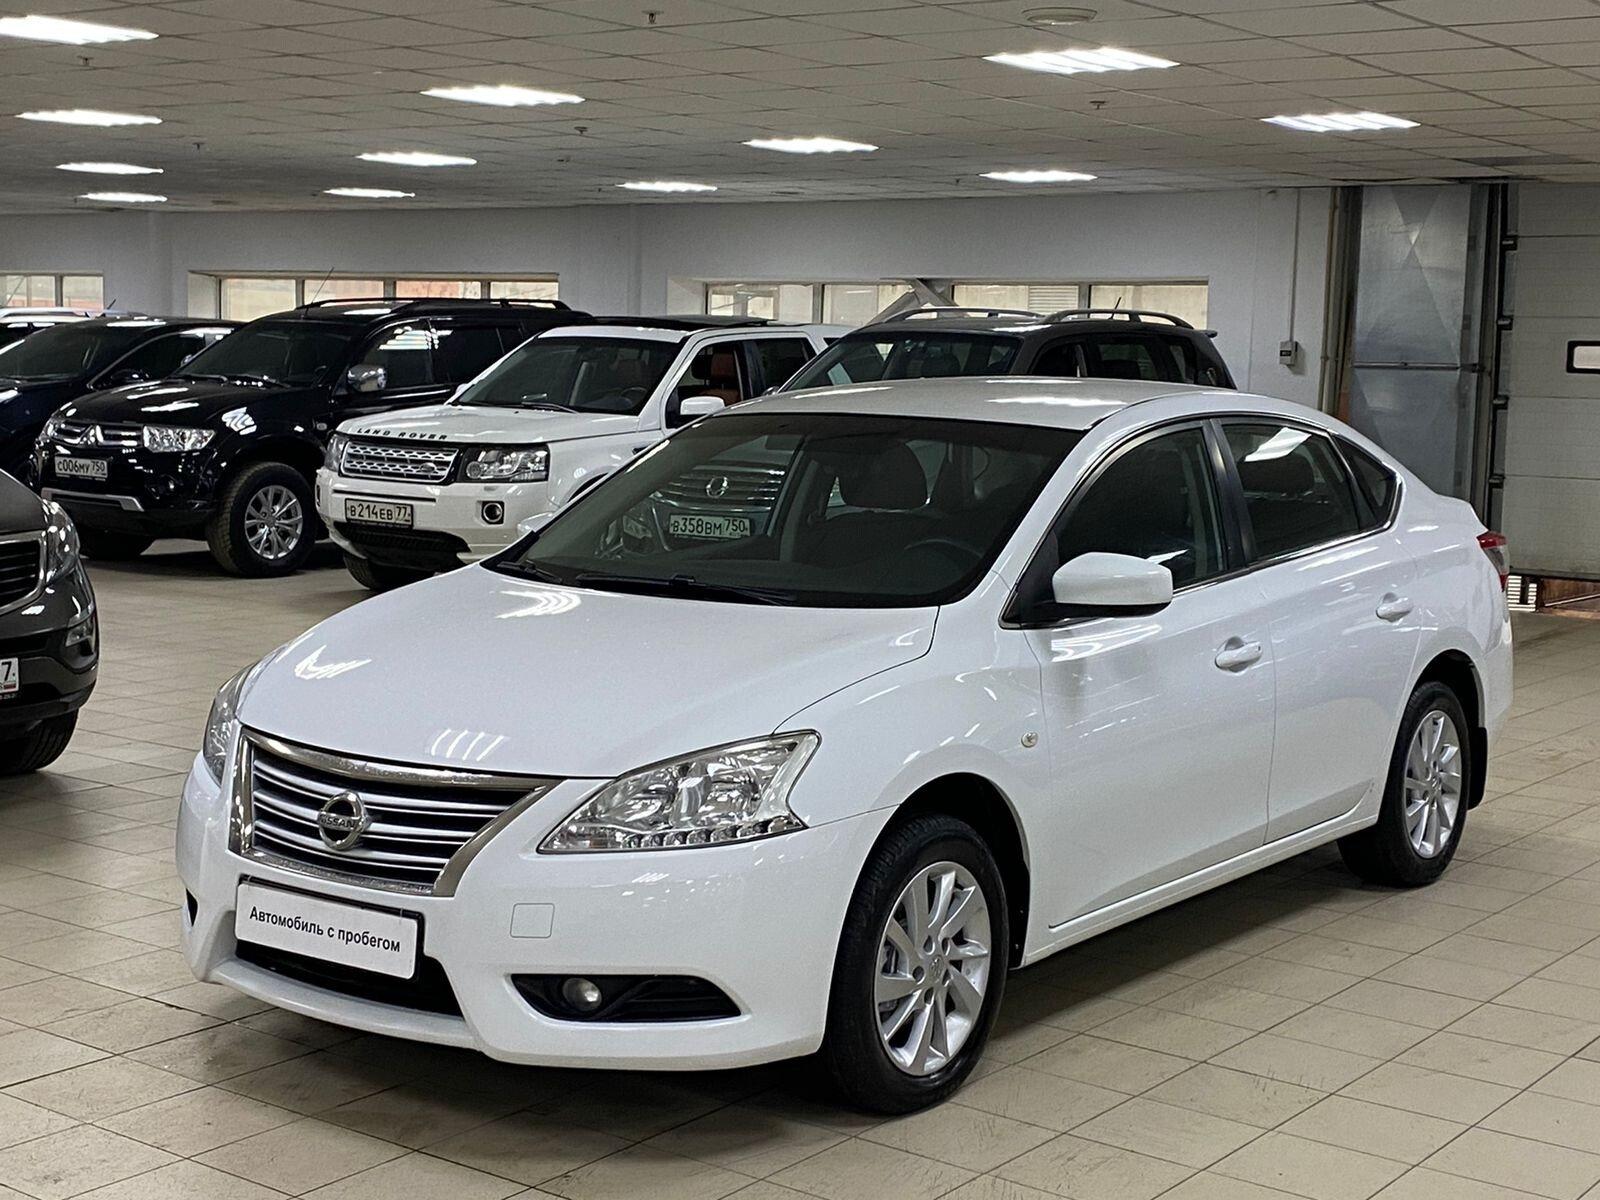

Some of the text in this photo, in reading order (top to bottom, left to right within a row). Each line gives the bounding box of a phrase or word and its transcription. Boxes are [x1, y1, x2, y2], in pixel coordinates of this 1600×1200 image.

[357, 428, 448, 440] LAND ROVER
[350, 503, 408, 521] В214ЕВ 77
[724, 518, 746, 533] 750
[249, 906, 401, 953] Автомобиль с пробегом
